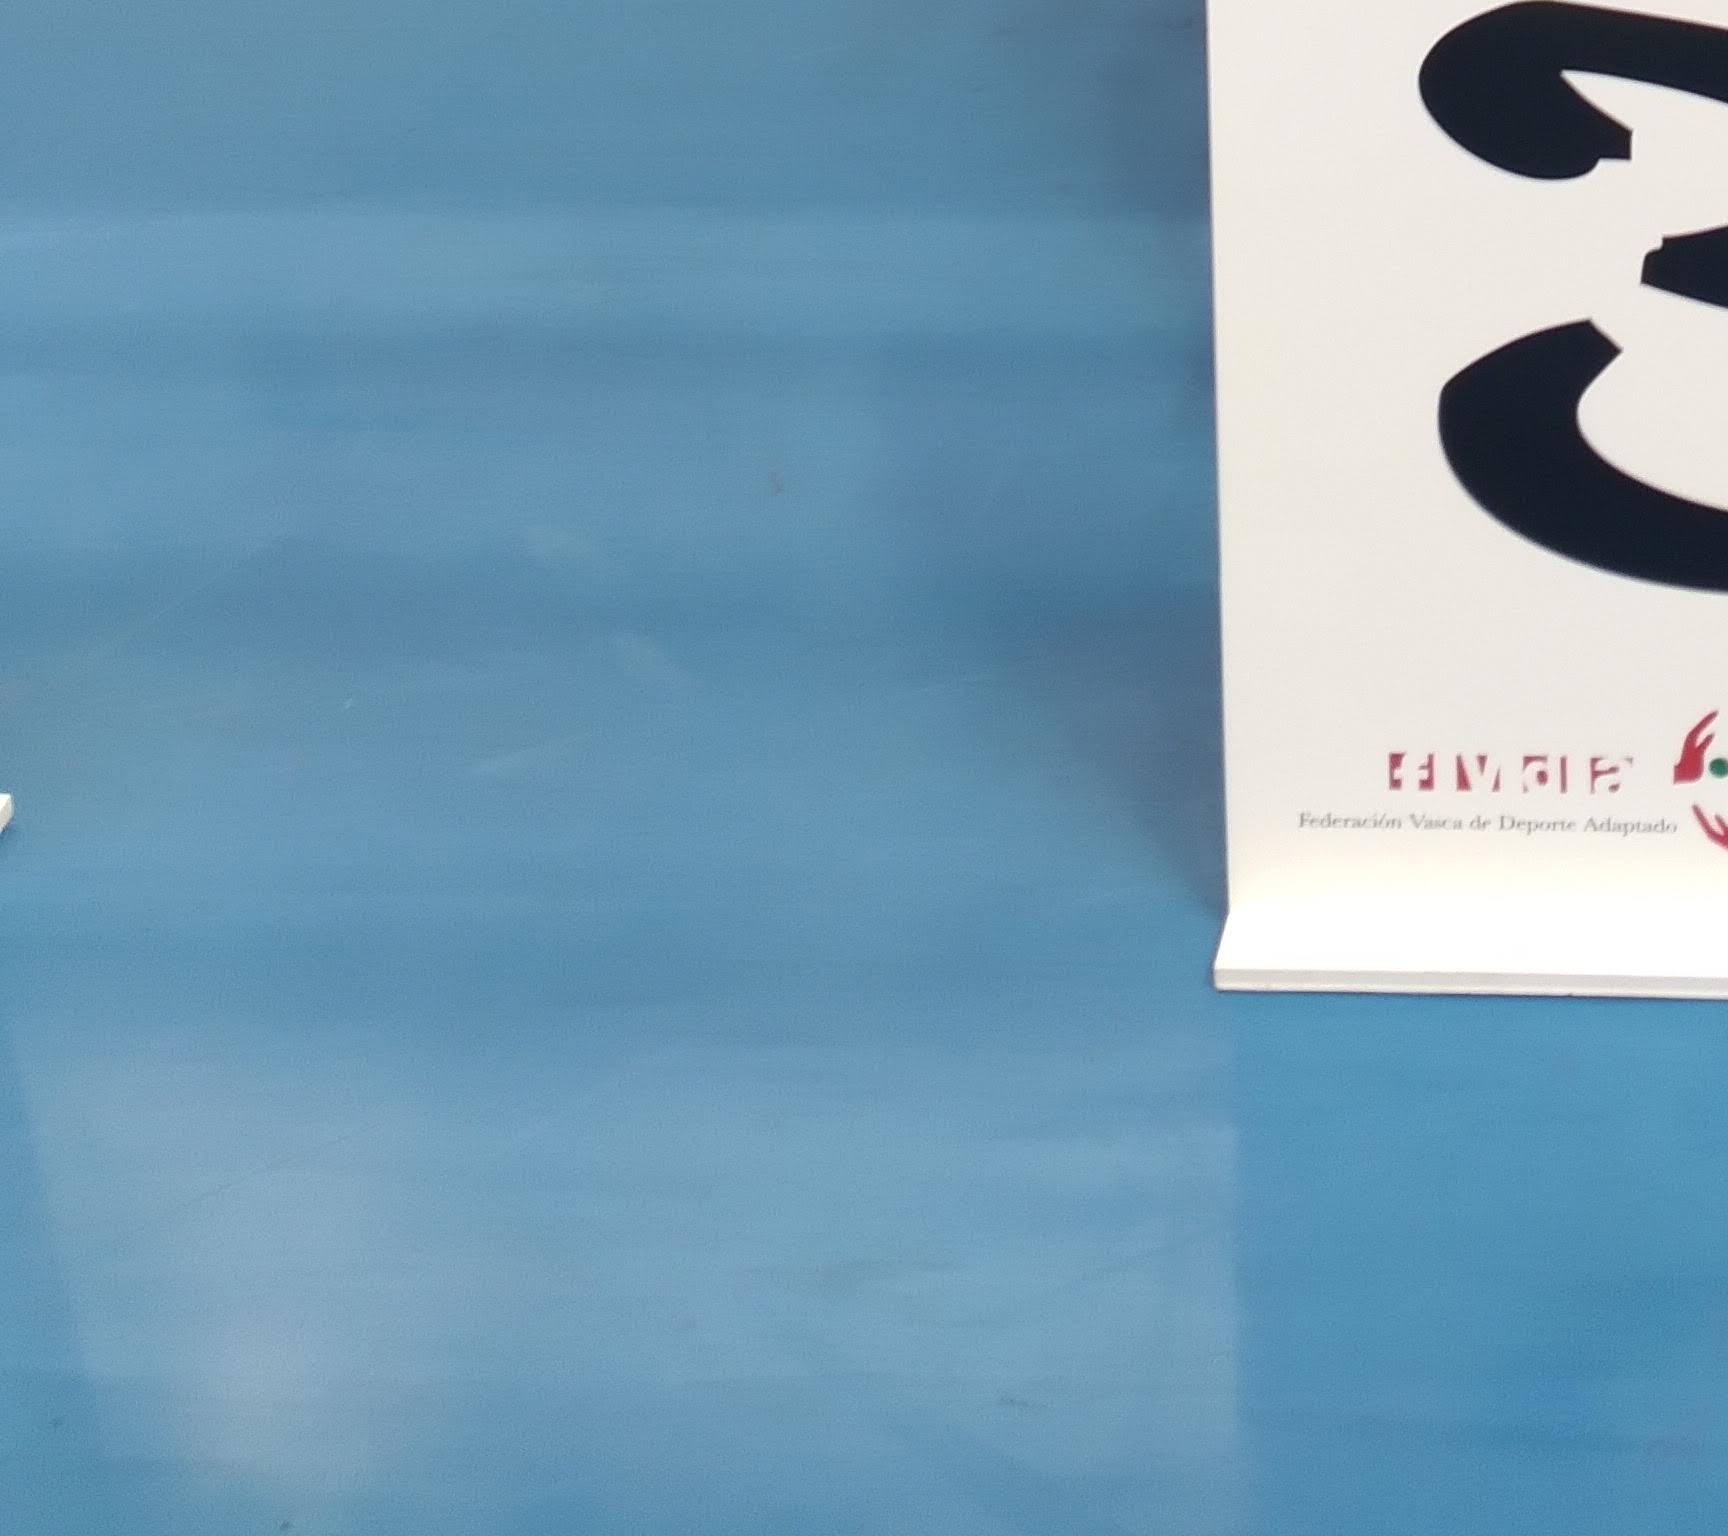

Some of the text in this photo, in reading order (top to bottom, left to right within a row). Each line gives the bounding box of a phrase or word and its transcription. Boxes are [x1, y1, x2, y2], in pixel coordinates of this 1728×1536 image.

[1298, 811, 1679, 837] Federación Vasca de Deporte Adaptado
